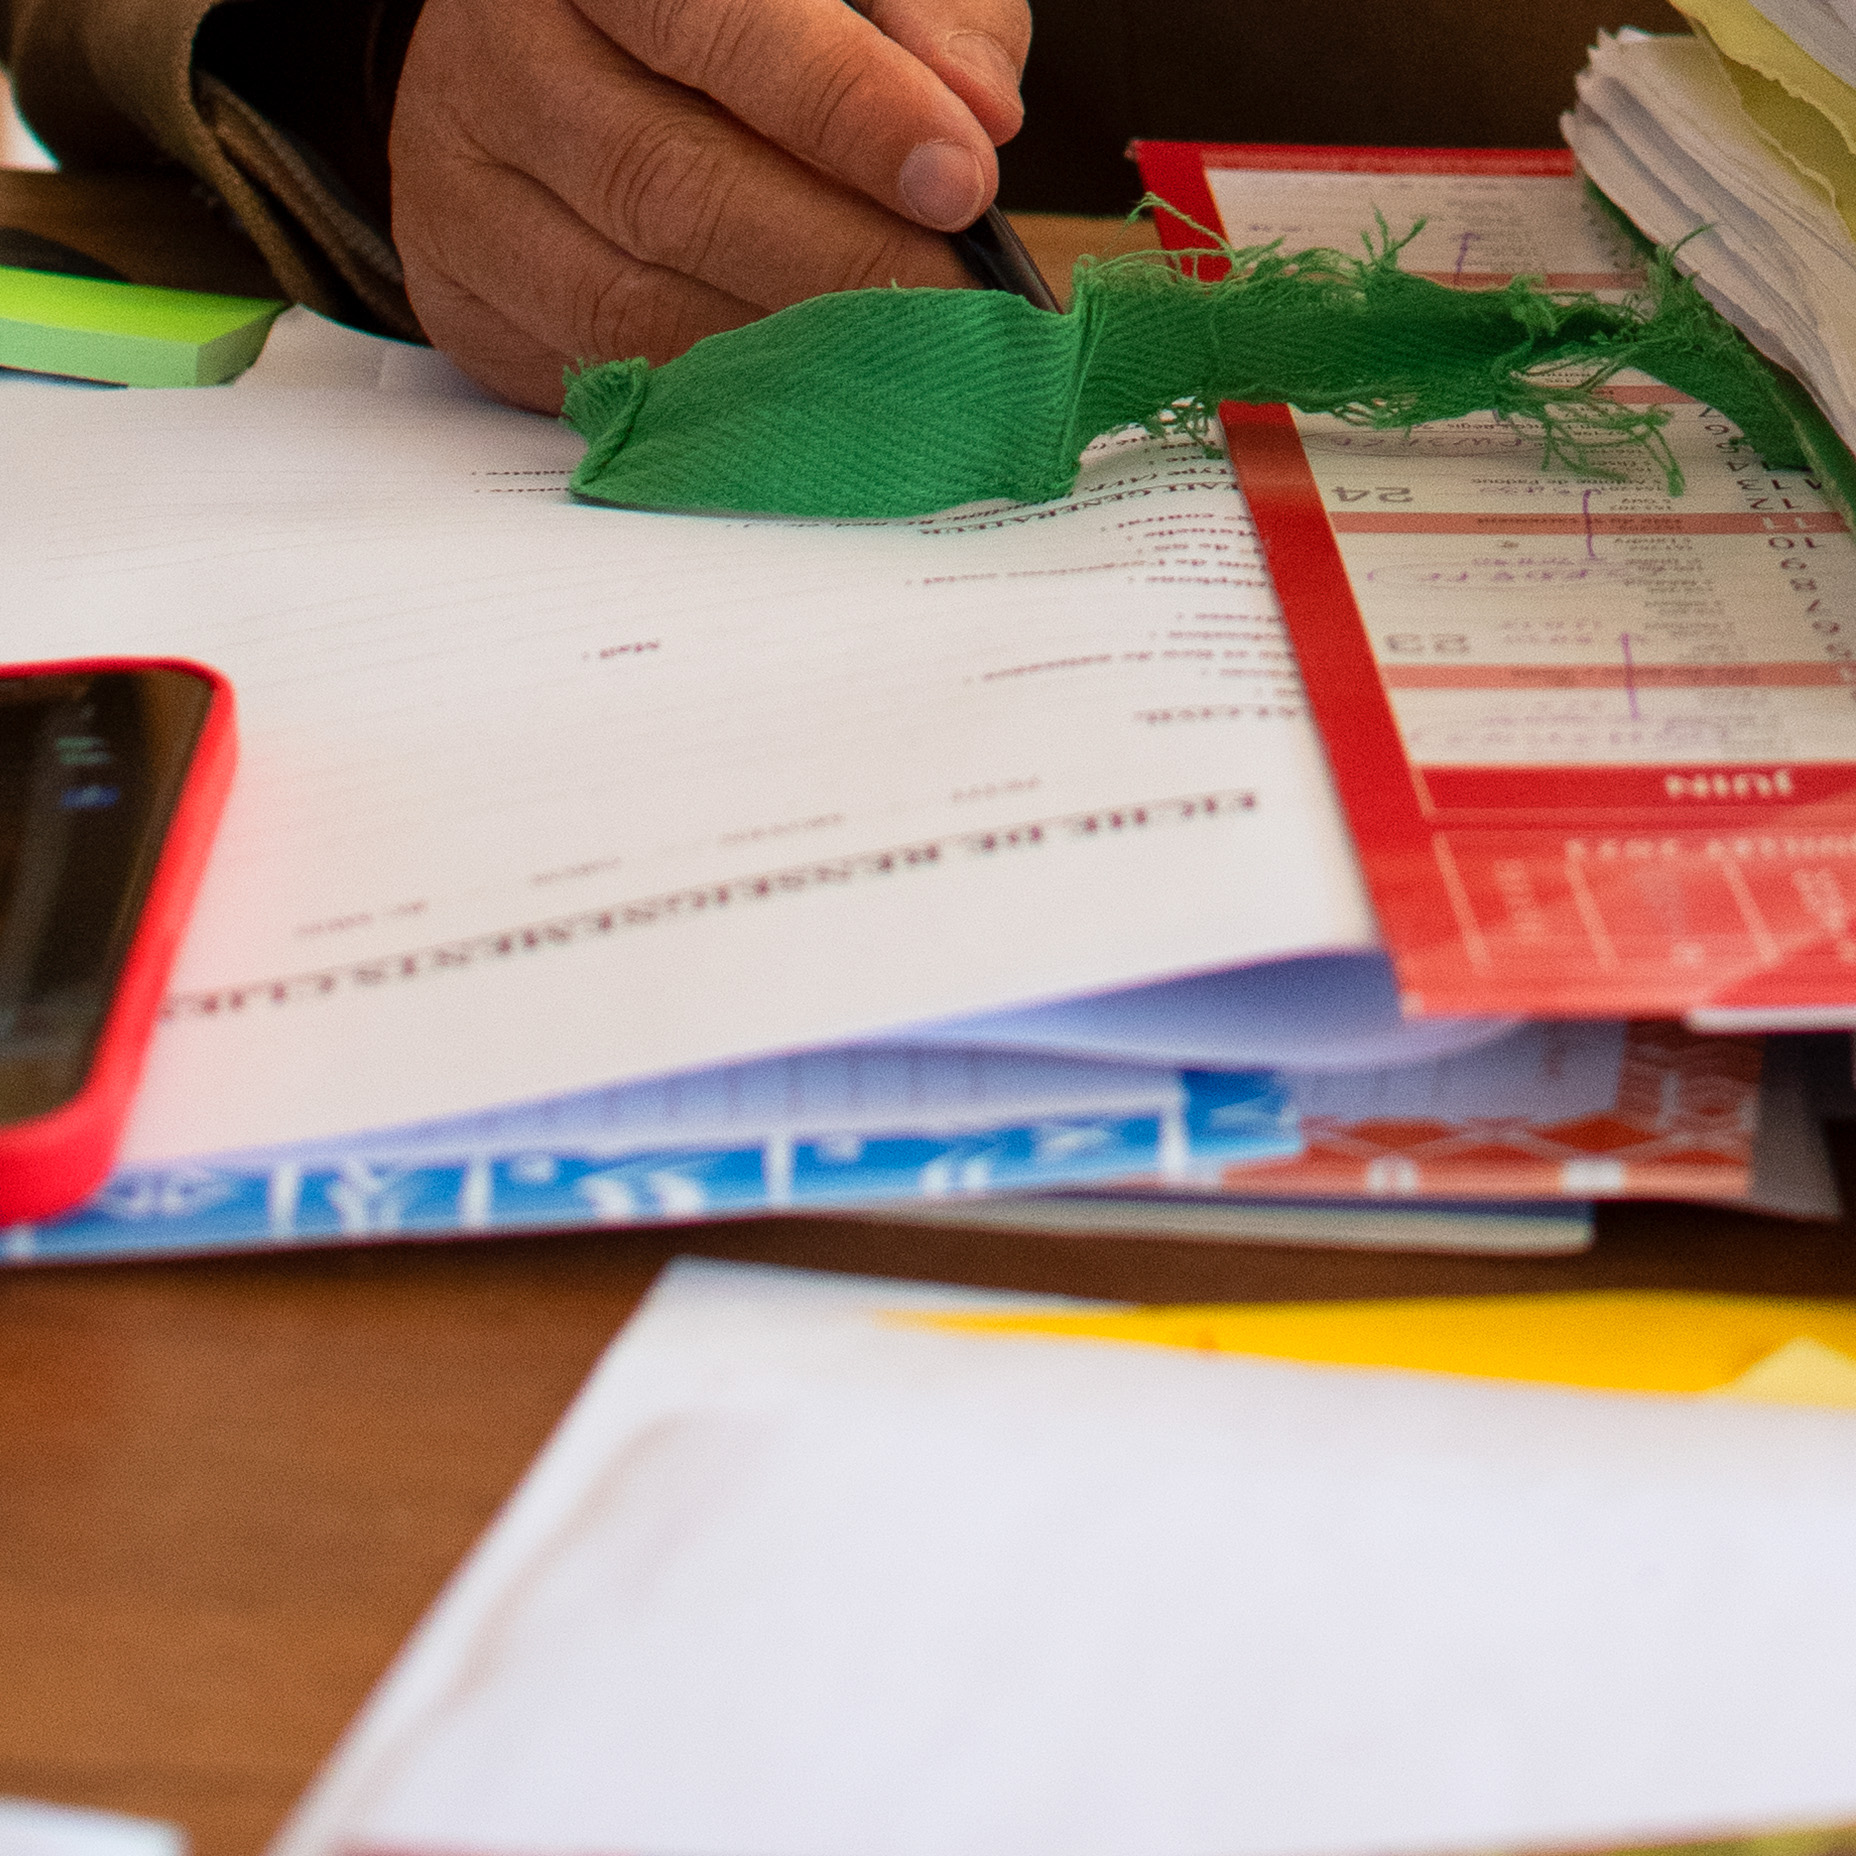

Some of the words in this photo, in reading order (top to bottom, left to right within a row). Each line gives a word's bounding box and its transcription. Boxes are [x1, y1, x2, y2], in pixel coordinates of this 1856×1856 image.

[1330, 485, 1414, 504] 24
[1736, 478, 1793, 491] 13
[1747, 497, 1804, 510] 12
[1761, 516, 1820, 530] 11
[1767, 537, 1824, 549] 10
[1383, 633, 1471, 659] 23
[1664, 768, 1793, 800] JUIN
[1062, 790, 1260, 836] FICHE
[955, 824, 1044, 859] DE
[352, 844, 942, 989] RENSEIGNEMENTS
